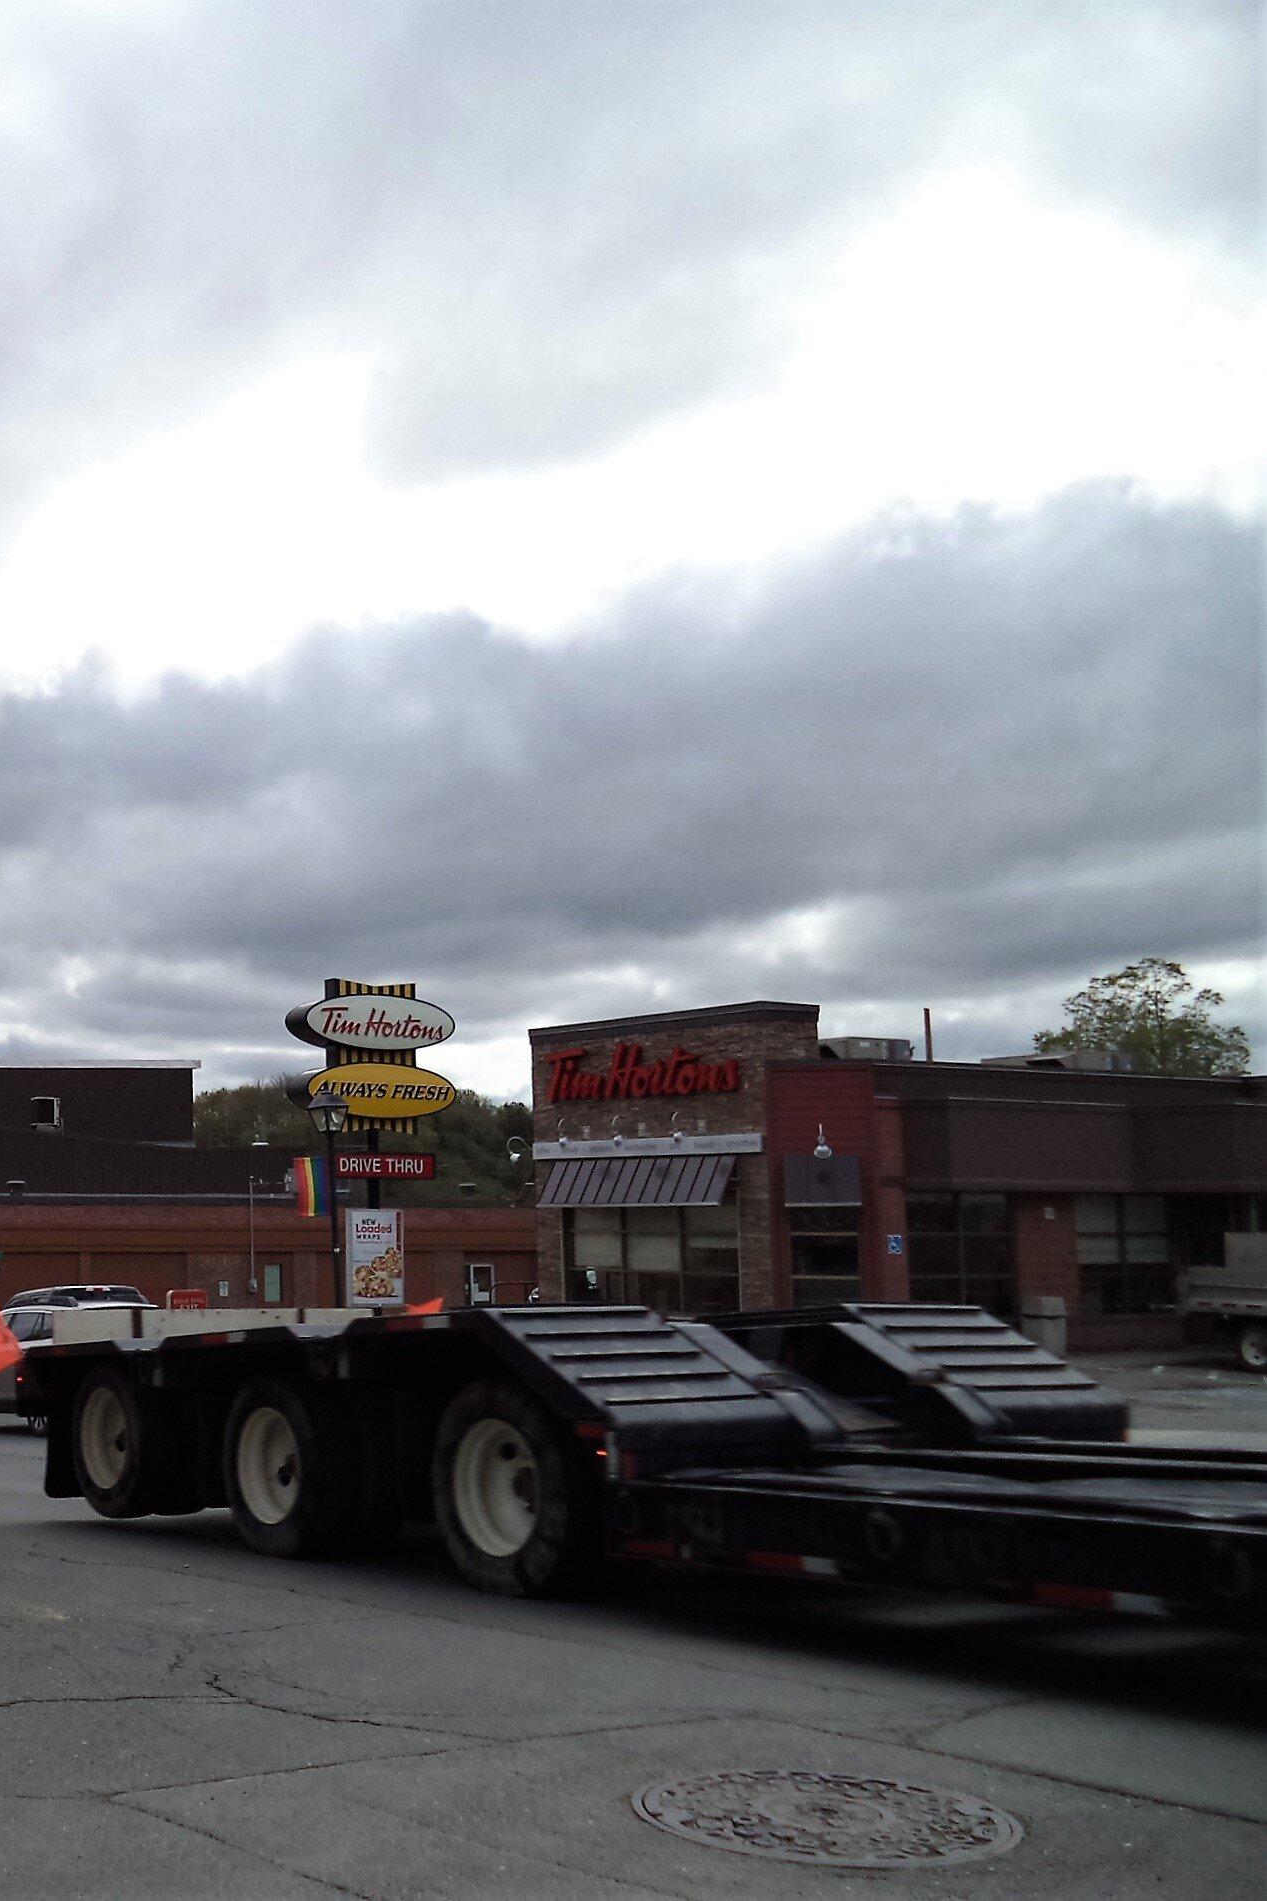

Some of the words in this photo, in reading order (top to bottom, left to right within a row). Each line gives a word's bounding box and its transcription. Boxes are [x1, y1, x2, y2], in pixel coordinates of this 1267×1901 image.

[321, 1005, 361, 1037] Tim
[364, 1007, 445, 1041] Hortons
[544, 1047, 607, 1103] Tim
[605, 1042, 741, 1100] Hortons
[313, 1080, 389, 1100] ALWAYS
[390, 1084, 452, 1103] FRESH
[339, 1157, 382, 1174] DRIVE
[385, 1158, 424, 1175] THRU
[355, 1223, 392, 1234] Loaded
[361, 1218, 376, 1226] NEW
